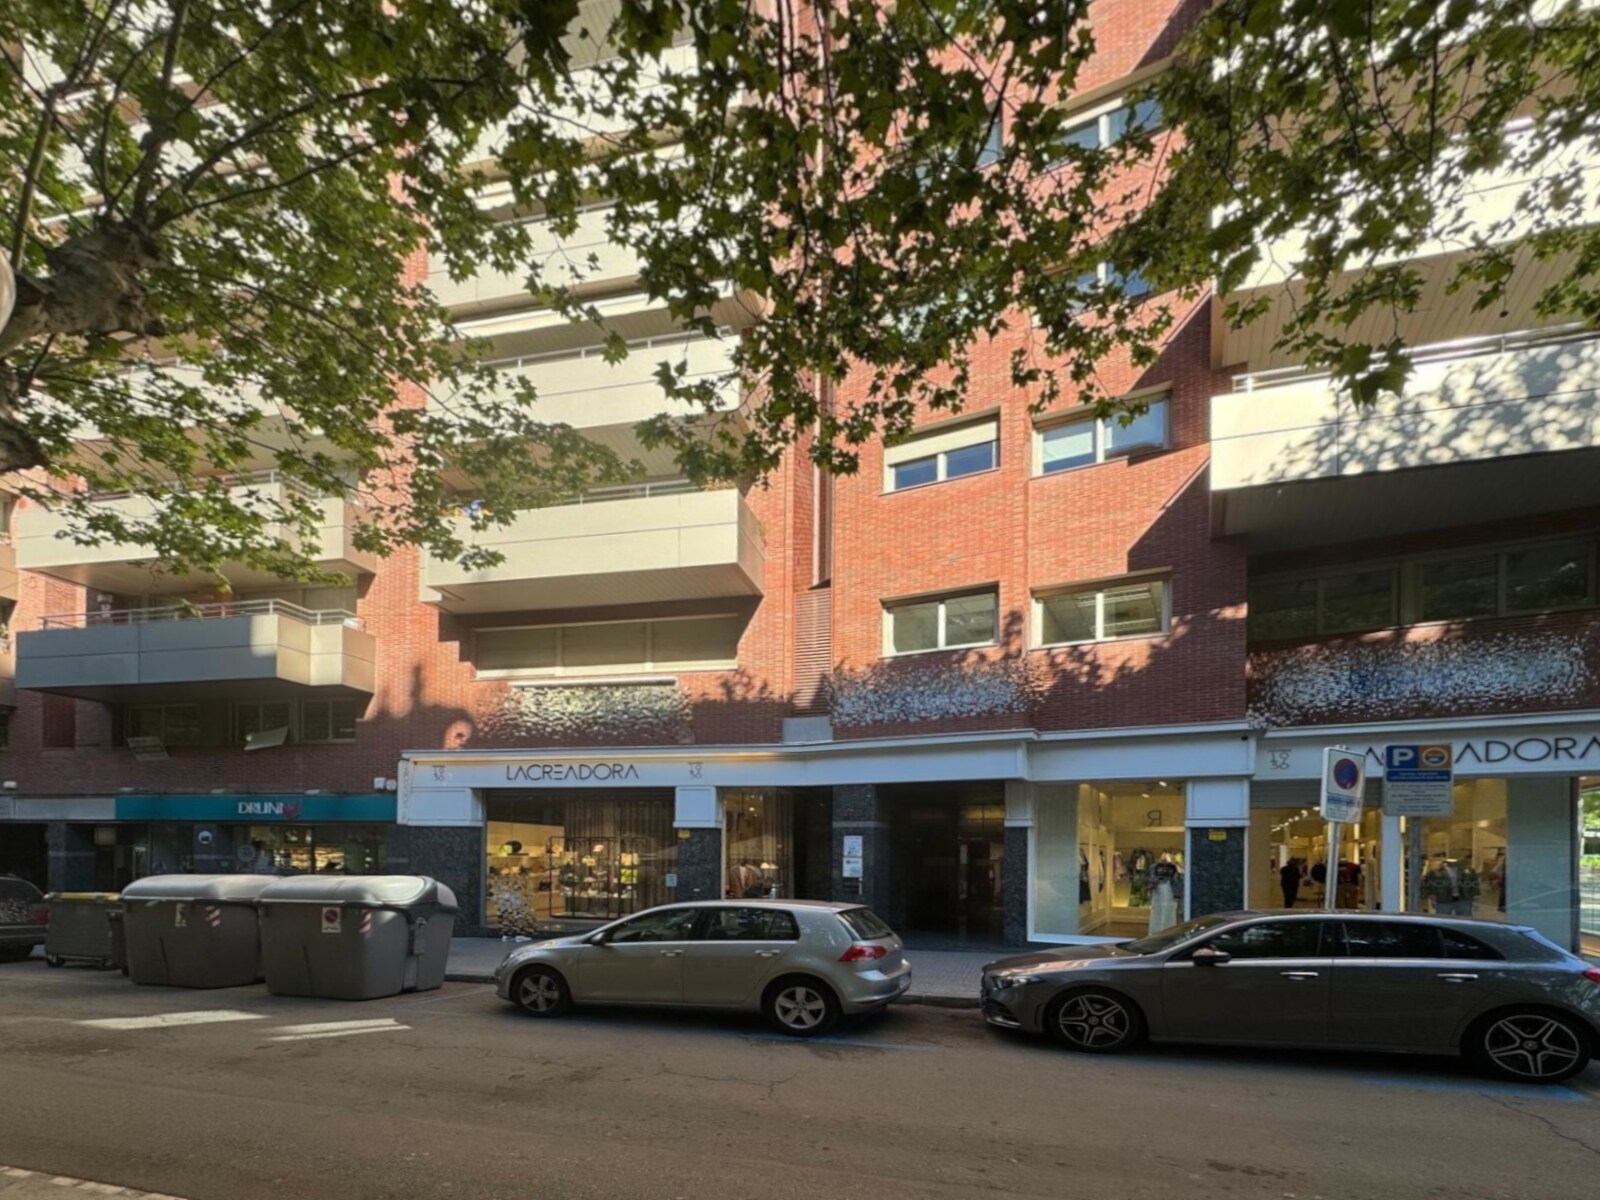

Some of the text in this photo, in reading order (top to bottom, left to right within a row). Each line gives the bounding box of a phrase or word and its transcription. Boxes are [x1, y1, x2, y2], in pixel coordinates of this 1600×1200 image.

[1392, 748, 1414, 766] P
[506, 763, 639, 781] LACREADORA
[238, 801, 284, 814] DRUNI
